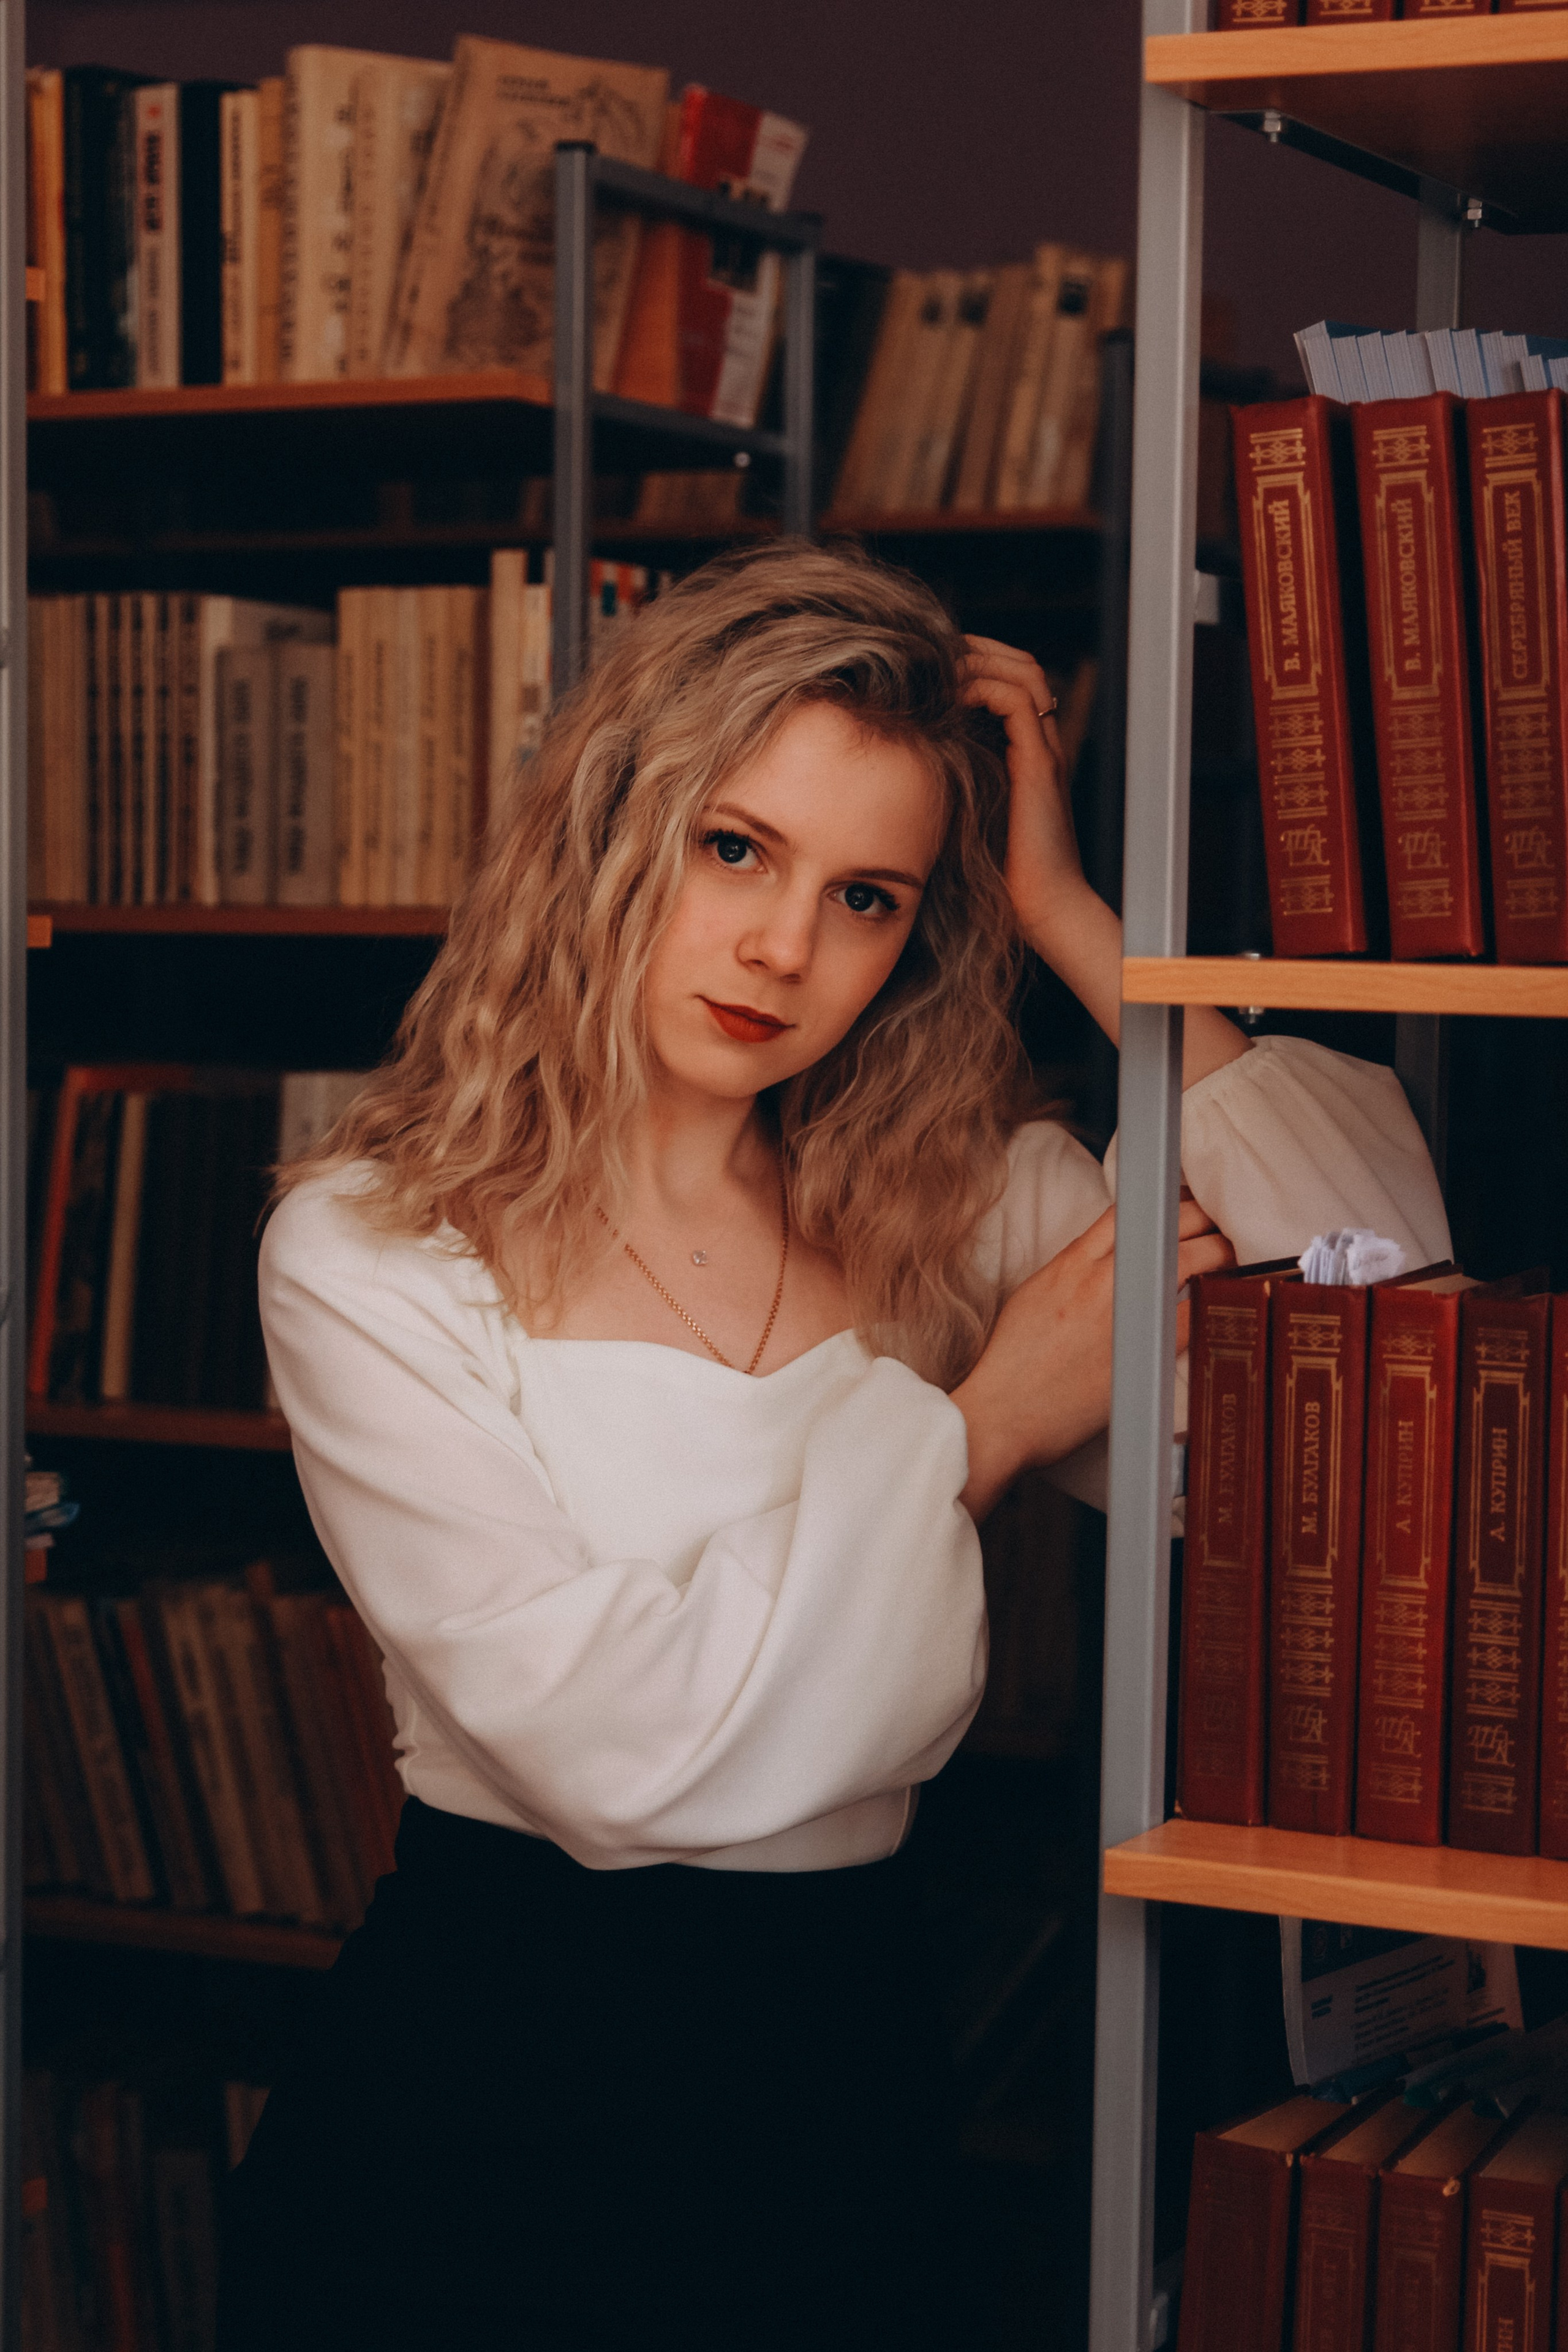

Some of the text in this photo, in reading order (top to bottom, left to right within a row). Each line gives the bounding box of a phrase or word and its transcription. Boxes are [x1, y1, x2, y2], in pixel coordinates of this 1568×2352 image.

[1267, 499, 1301, 672] В. МАЯКОВСКИЙ
[1390, 498, 1422, 672] В. МАЯКОВСКИЙ
[1501, 490, 1528, 680] СЕРЕБРЯНЫЙ ВЕК
[1301, 1401, 1321, 1535] М. БУЛГАКОВ
[1396, 1419, 1414, 1507] КУПРИН
[1489, 1427, 1508, 1543] А. КУПРИН
